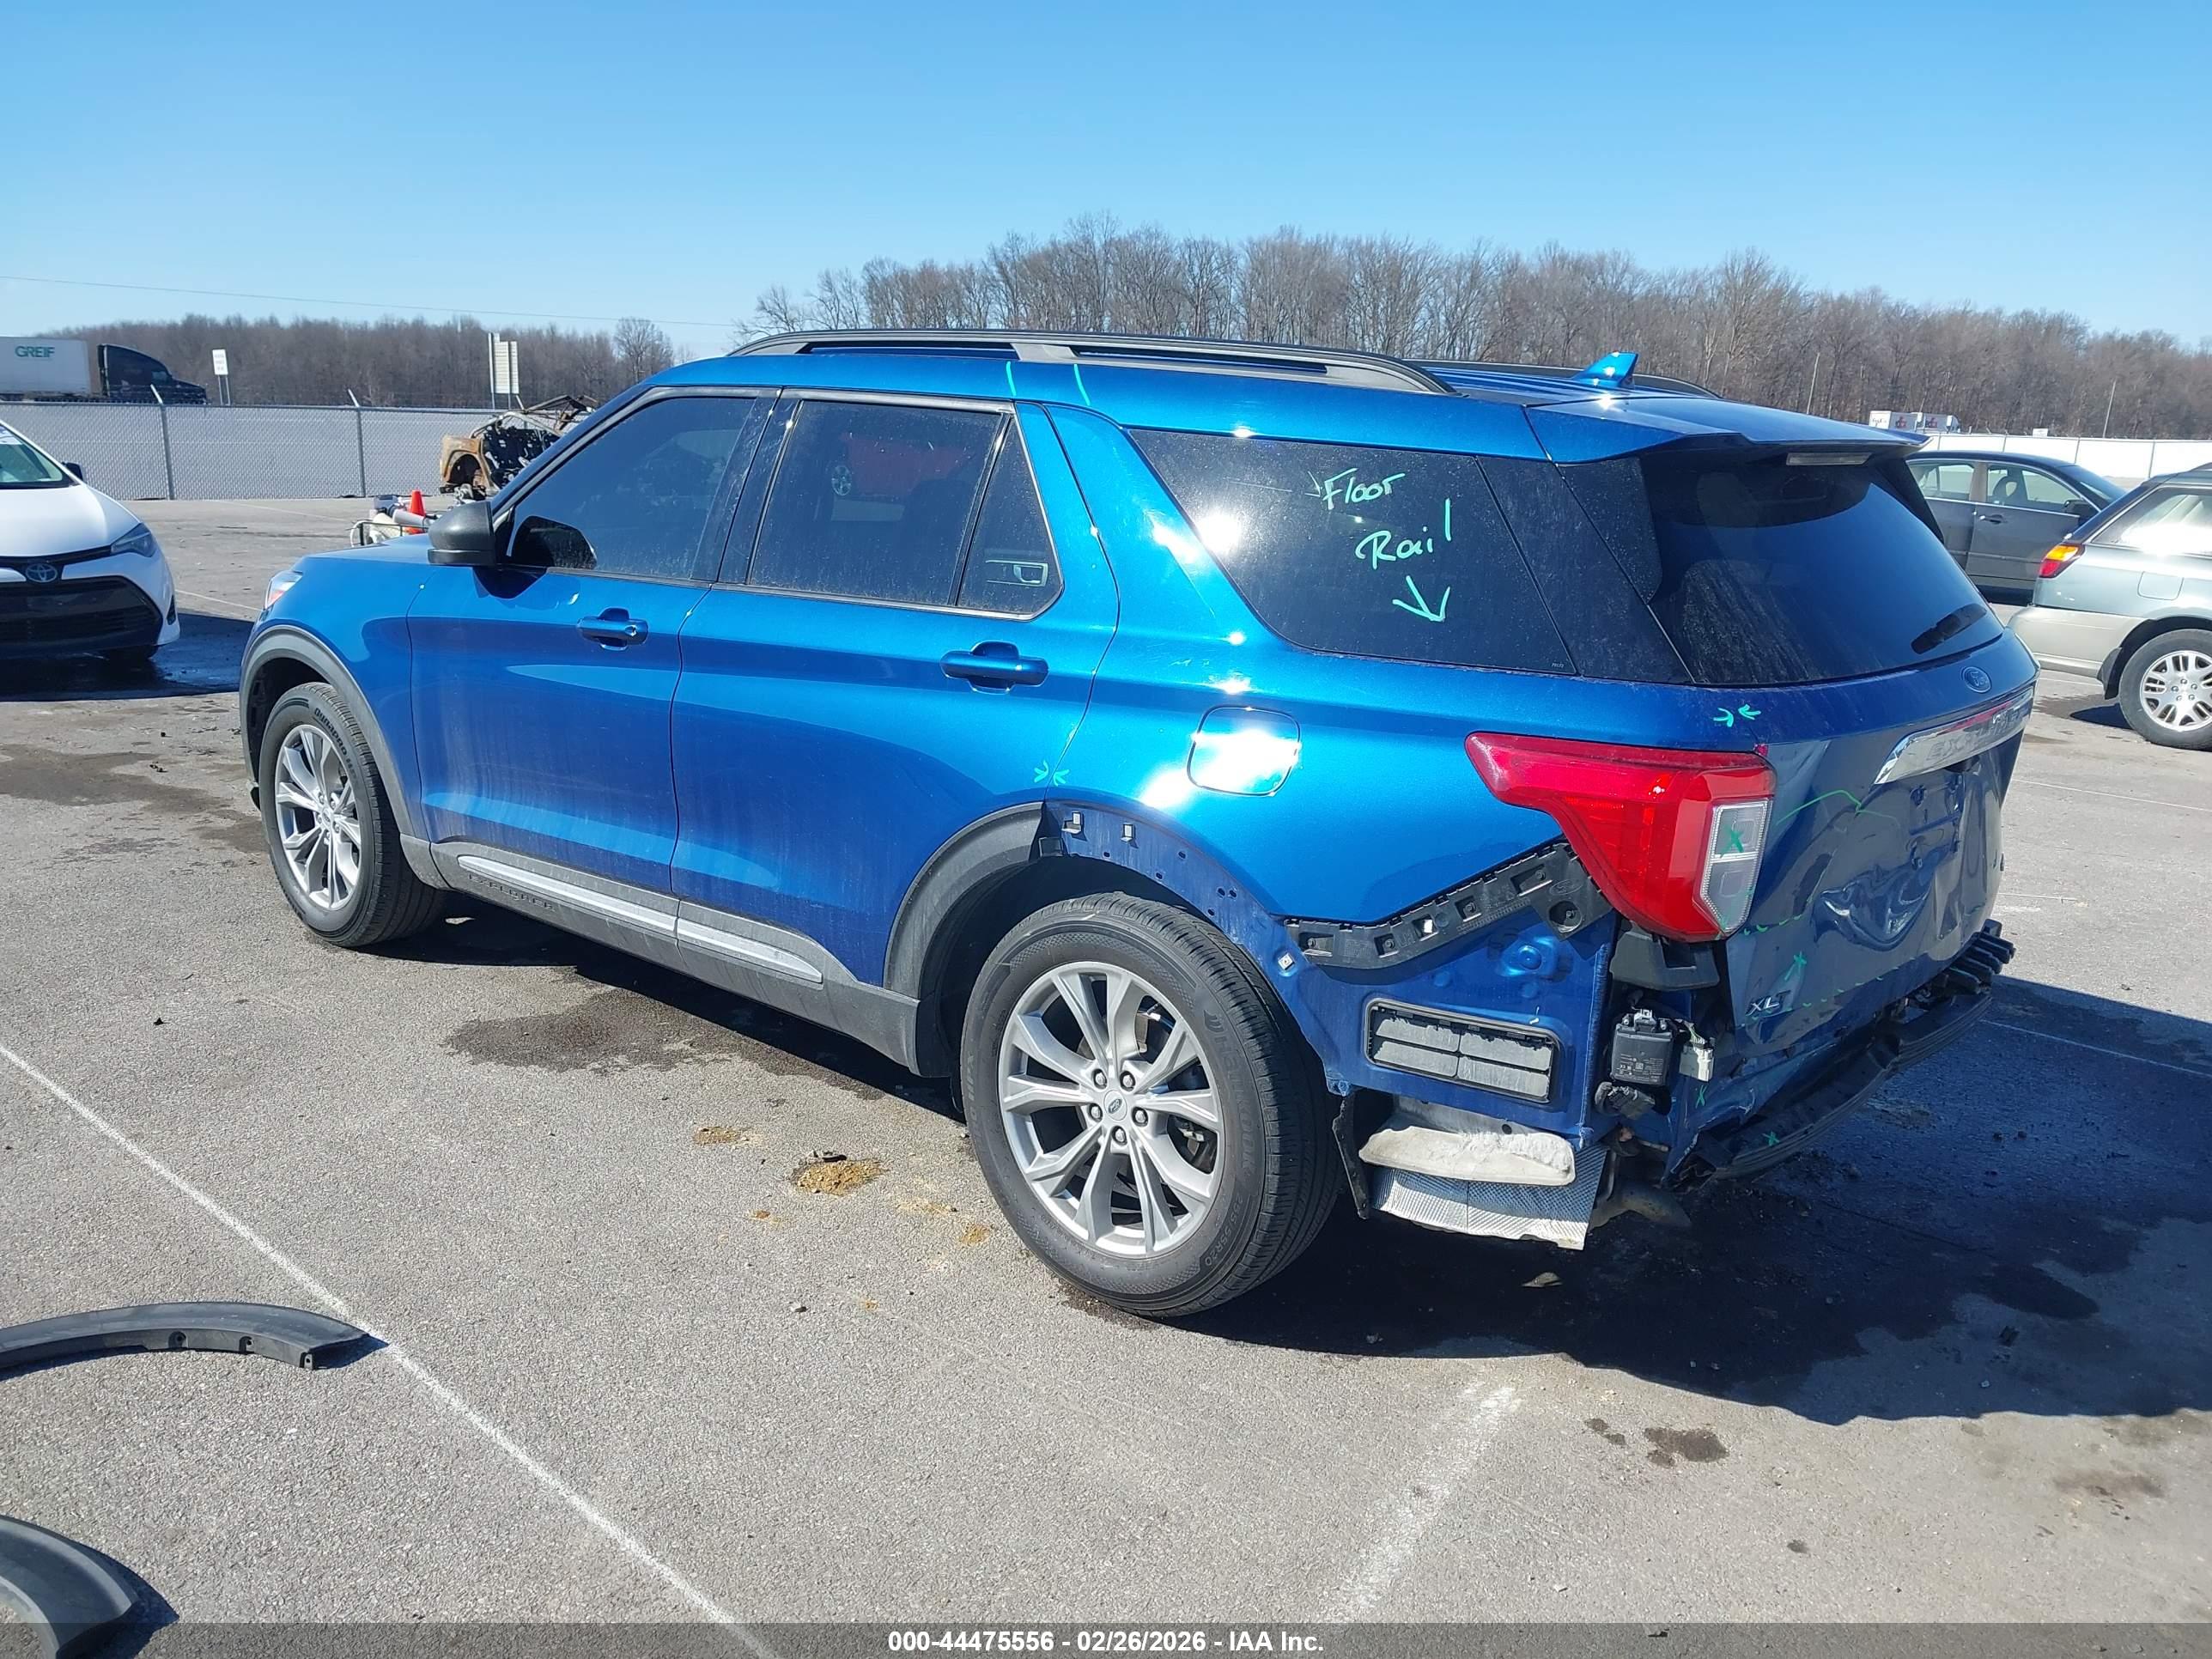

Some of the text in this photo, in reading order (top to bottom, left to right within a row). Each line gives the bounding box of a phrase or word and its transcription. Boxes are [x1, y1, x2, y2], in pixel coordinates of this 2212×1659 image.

[15, 345, 56, 358] GREIF
[1322, 468, 1406, 510] Floor
[1355, 498, 1451, 570] Rail
[1745, 989, 1792, 1017] XLT
[1204, 1192, 1243, 1267] 255/55R20
